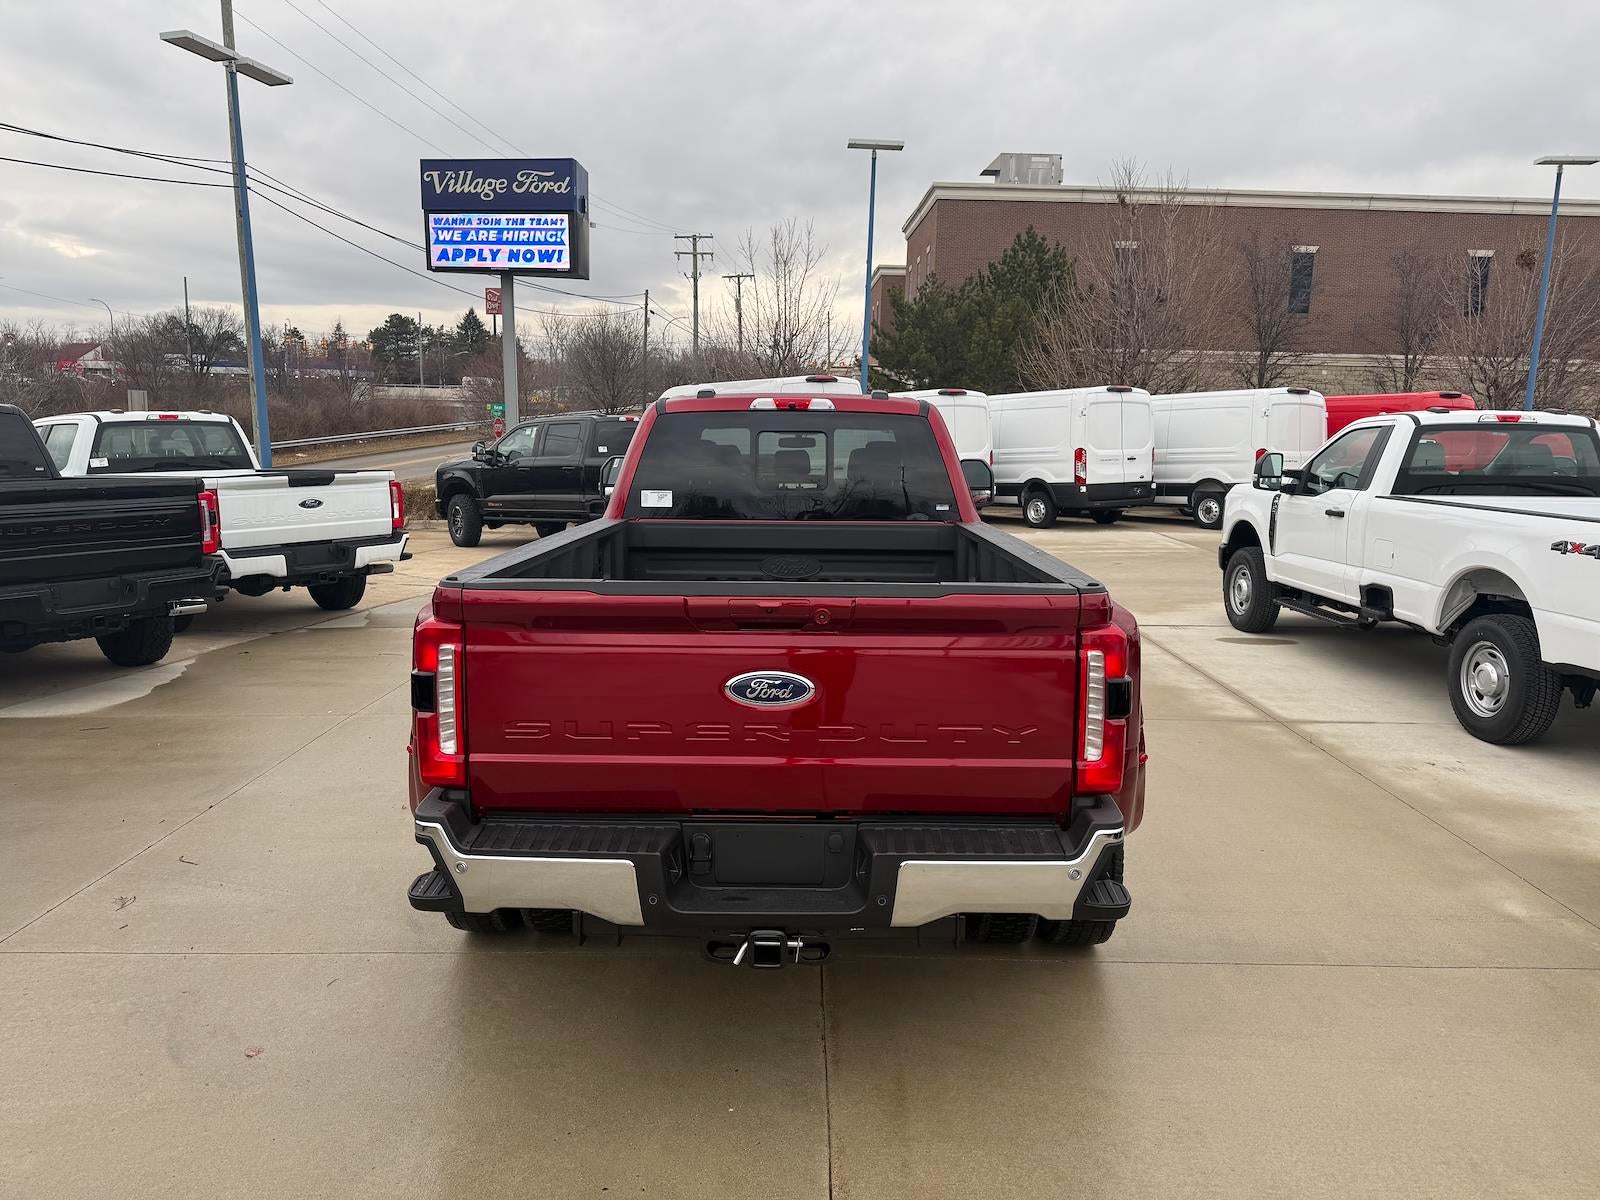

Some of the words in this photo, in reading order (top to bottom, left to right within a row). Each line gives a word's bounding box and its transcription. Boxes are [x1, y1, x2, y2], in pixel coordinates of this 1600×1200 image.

[423, 170, 508, 200] Village
[512, 169, 571, 194] Ford
[433, 217, 473, 226] WANNA
[476, 217, 501, 226] JOIN
[506, 218, 525, 226] THE
[529, 218, 565, 226] TEAM?
[437, 229, 463, 241] WE
[466, 230, 498, 242] ARE
[502, 230, 562, 242] HIRING!
[436, 248, 502, 262] APPLY
[507, 249, 564, 263] NOW!
[231, 512, 322, 526] SUPER
[325, 507, 384, 519] DUTY
[0, 522, 91, 536] UPER
[99, 518, 171, 530] DUTY
[745, 678, 794, 699] Ford
[503, 719, 790, 742] SUPER
[817, 722, 1038, 743] DUTY
